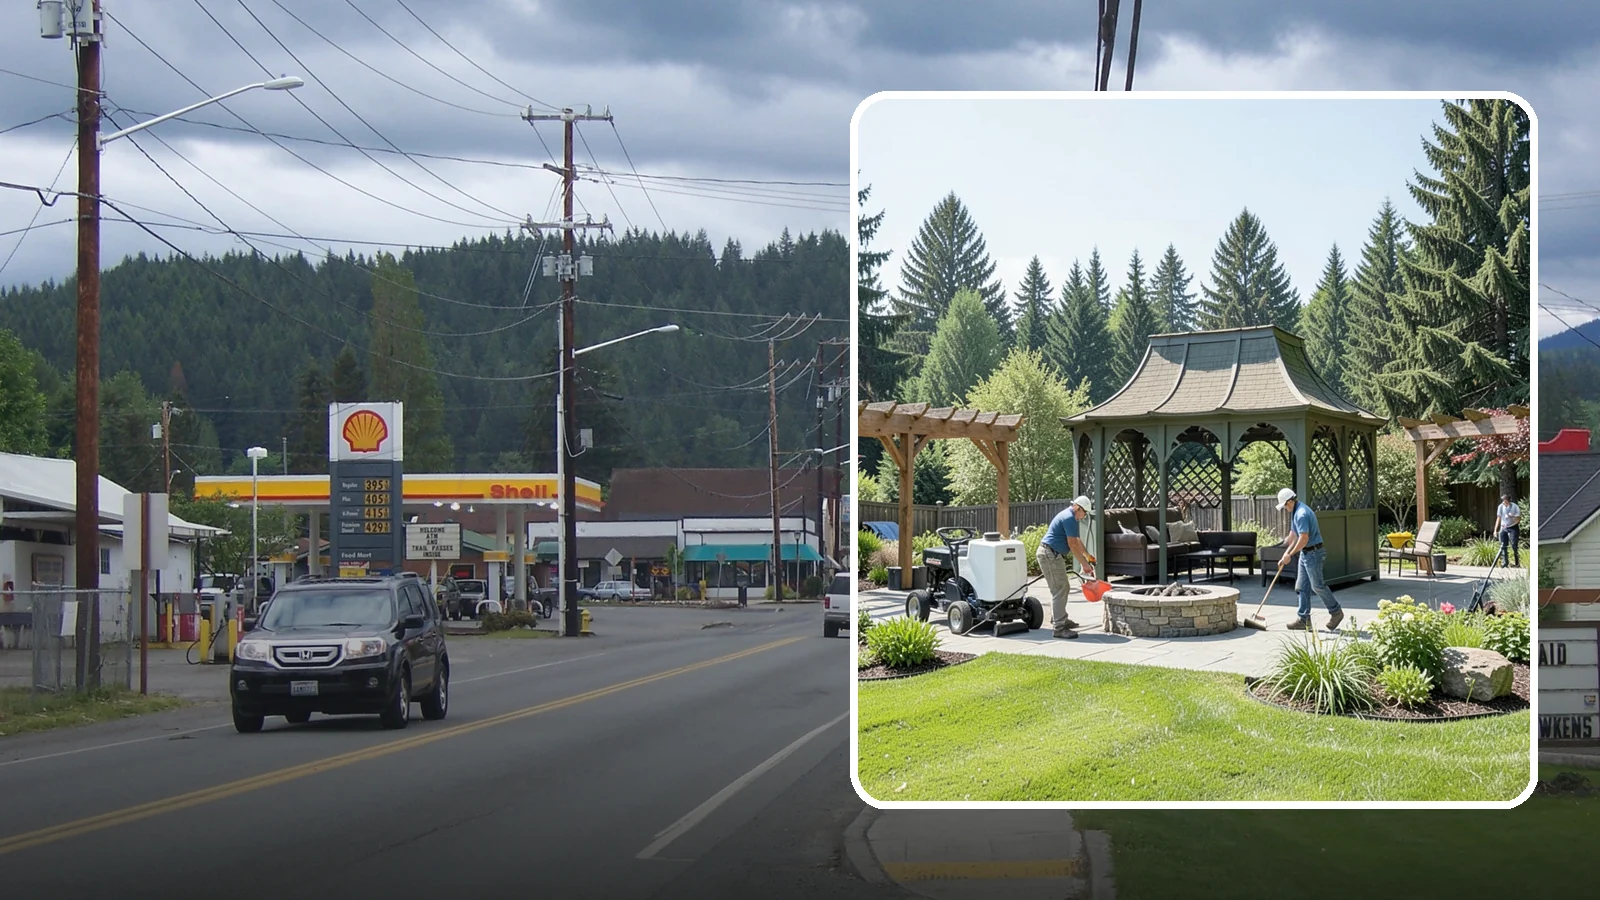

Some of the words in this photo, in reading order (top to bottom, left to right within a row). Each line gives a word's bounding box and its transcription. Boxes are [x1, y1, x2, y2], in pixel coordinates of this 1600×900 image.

[365, 480, 384, 490] 395
[489, 484, 548, 499] Shell
[365, 494, 384, 504] 405
[365, 508, 384, 518] 415
[365, 522, 384, 532] 429
[1538, 642, 1567, 666] AID
